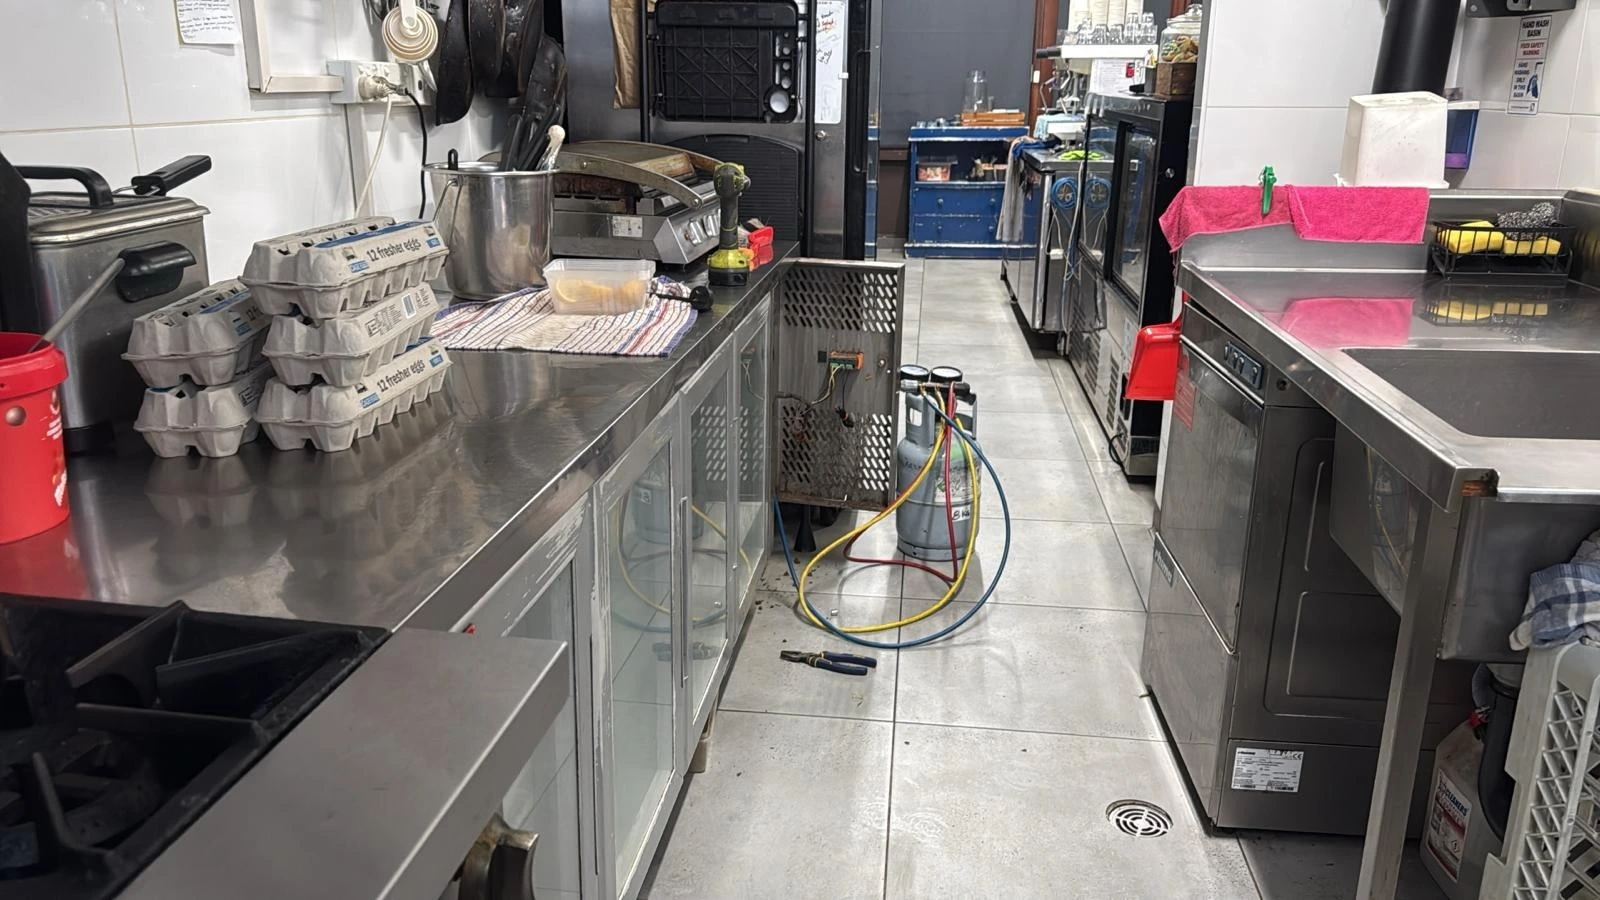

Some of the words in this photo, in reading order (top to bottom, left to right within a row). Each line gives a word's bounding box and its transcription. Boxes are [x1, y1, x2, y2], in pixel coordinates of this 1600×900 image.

[1535, 20, 1549, 28] WASH
[366, 249, 379, 262] 12
[377, 243, 404, 259] fresher
[403, 237, 422, 252] eggs
[377, 380, 388, 393] 12
[386, 368, 411, 388] fresher
[409, 359, 426, 374] eggs
